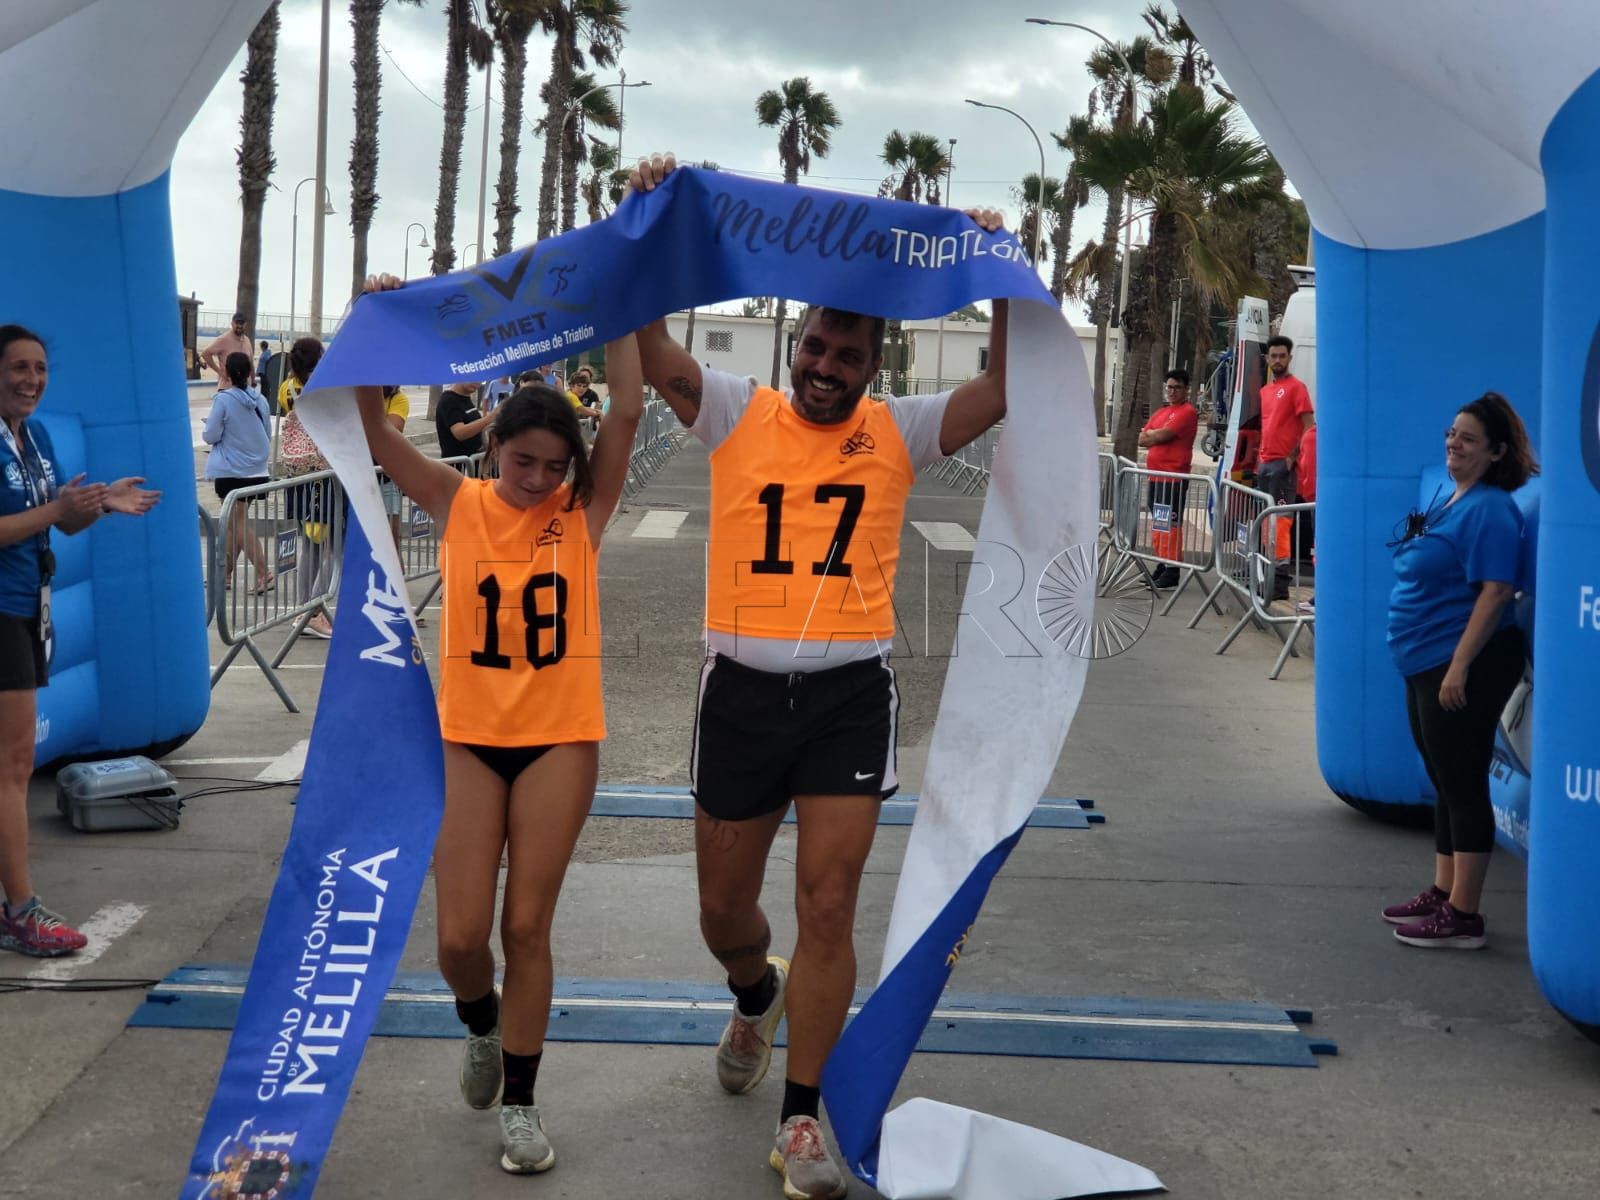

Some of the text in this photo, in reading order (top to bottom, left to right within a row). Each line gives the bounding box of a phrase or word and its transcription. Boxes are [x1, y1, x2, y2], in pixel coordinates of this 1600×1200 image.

[711, 191, 894, 262] Melilla
[449, 324, 594, 375] Federación Melillense de Triatlón
[482, 311, 547, 346] FMET
[751, 482, 866, 578] 17
[471, 571, 568, 671] 18
[257, 847, 347, 1101] CIUDAD AUTÓNOMA
[281, 846, 400, 1096] MELILLA
[287, 1060, 300, 1077] DE
